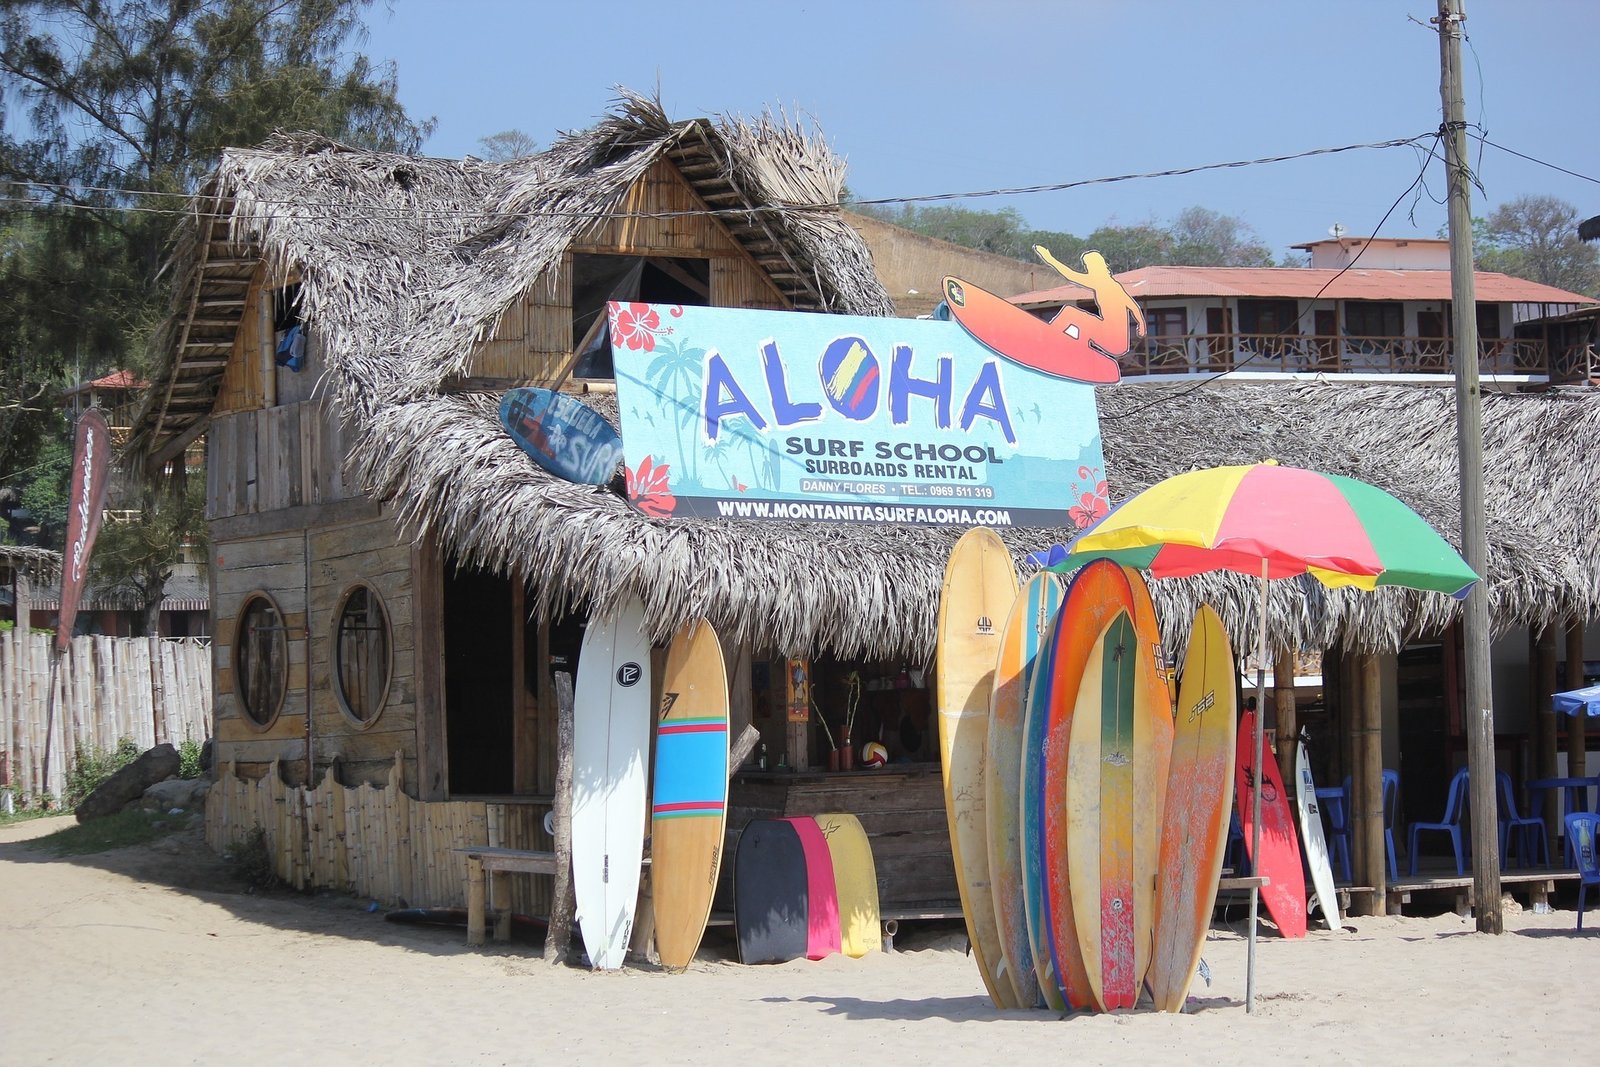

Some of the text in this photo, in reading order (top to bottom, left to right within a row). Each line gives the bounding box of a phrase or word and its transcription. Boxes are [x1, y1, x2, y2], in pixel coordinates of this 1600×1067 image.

[703, 336, 1017, 446] ALOHA
[785, 436, 1004, 464] SURF SCHOOL
[805, 458, 978, 480] SURBOARDS RENTAL
[802, 481, 841, 492] DANNY
[843, 482, 886, 494] FLORES
[930, 485, 954, 497] 0969
[956, 486, 973, 497] 511
[975, 486, 993, 498] 319
[717, 500, 1012, 526] WWW.MONTANITASURFALOHA.COM
